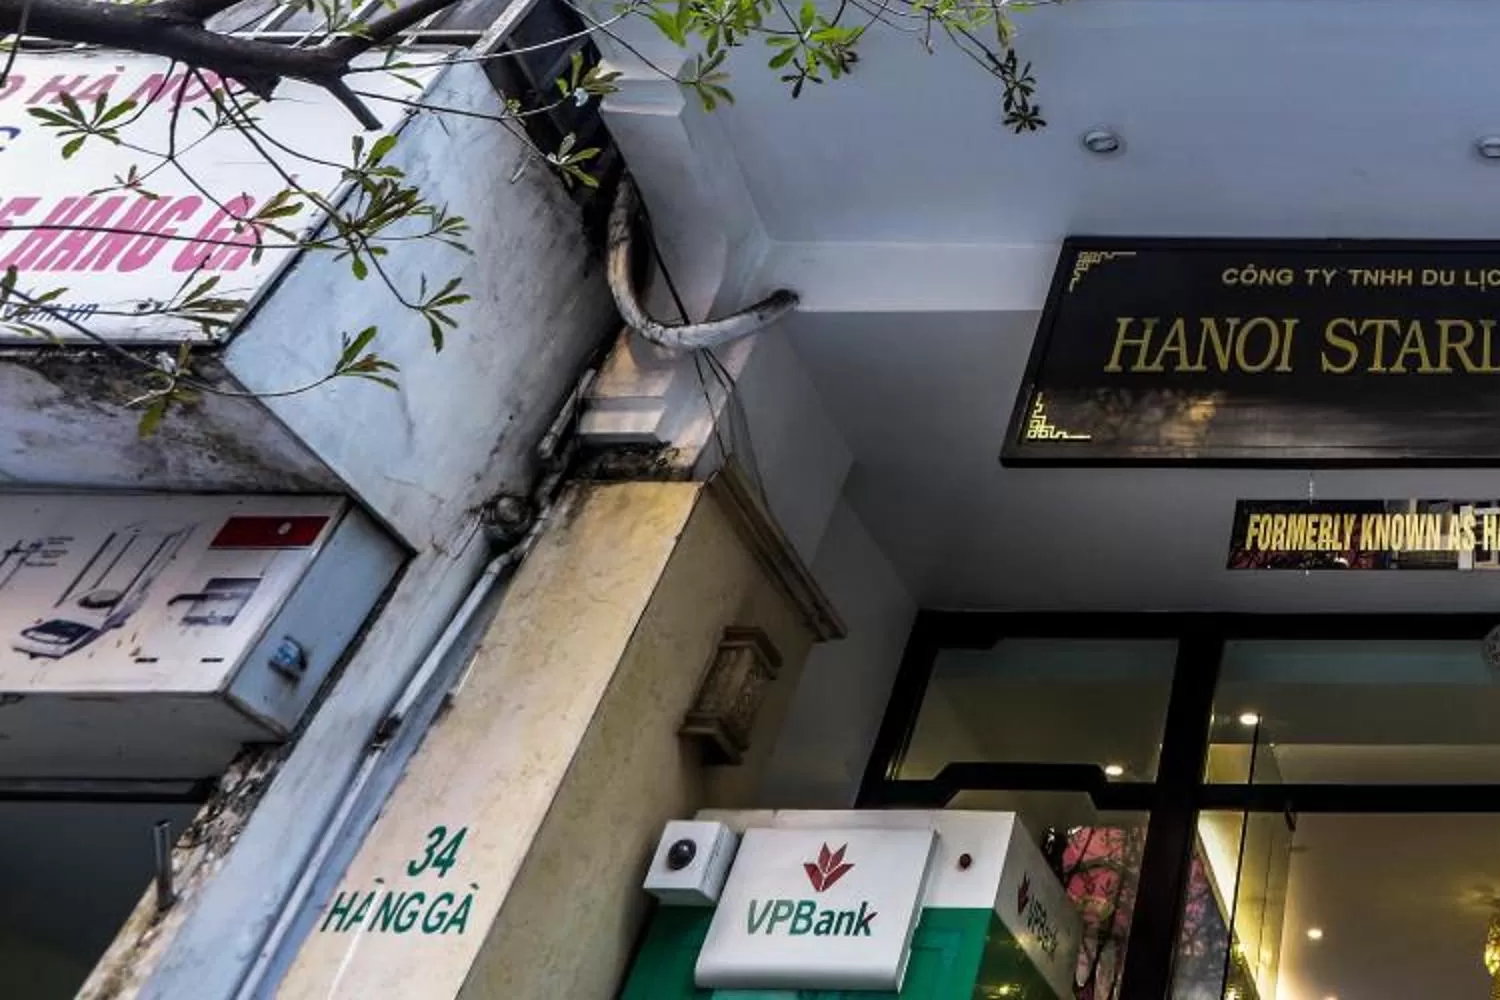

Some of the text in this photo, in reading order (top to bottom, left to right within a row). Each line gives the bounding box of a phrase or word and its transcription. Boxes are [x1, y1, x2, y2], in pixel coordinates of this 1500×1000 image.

[1221, 264, 1294, 286] CÔNG
[1304, 269, 1337, 286] TY
[1349, 269, 1413, 287] TNHH
[1421, 269, 1455, 287] DU
[1103, 316, 1299, 373] HANOI
[1245, 512, 1357, 551] FORMERLY
[1359, 512, 1441, 551] KNOWN
[1447, 512, 1475, 551] AS
[406, 825, 468, 878] 34
[319, 877, 480, 935] HÀNG GÀ
[747, 899, 878, 938] VPBank
